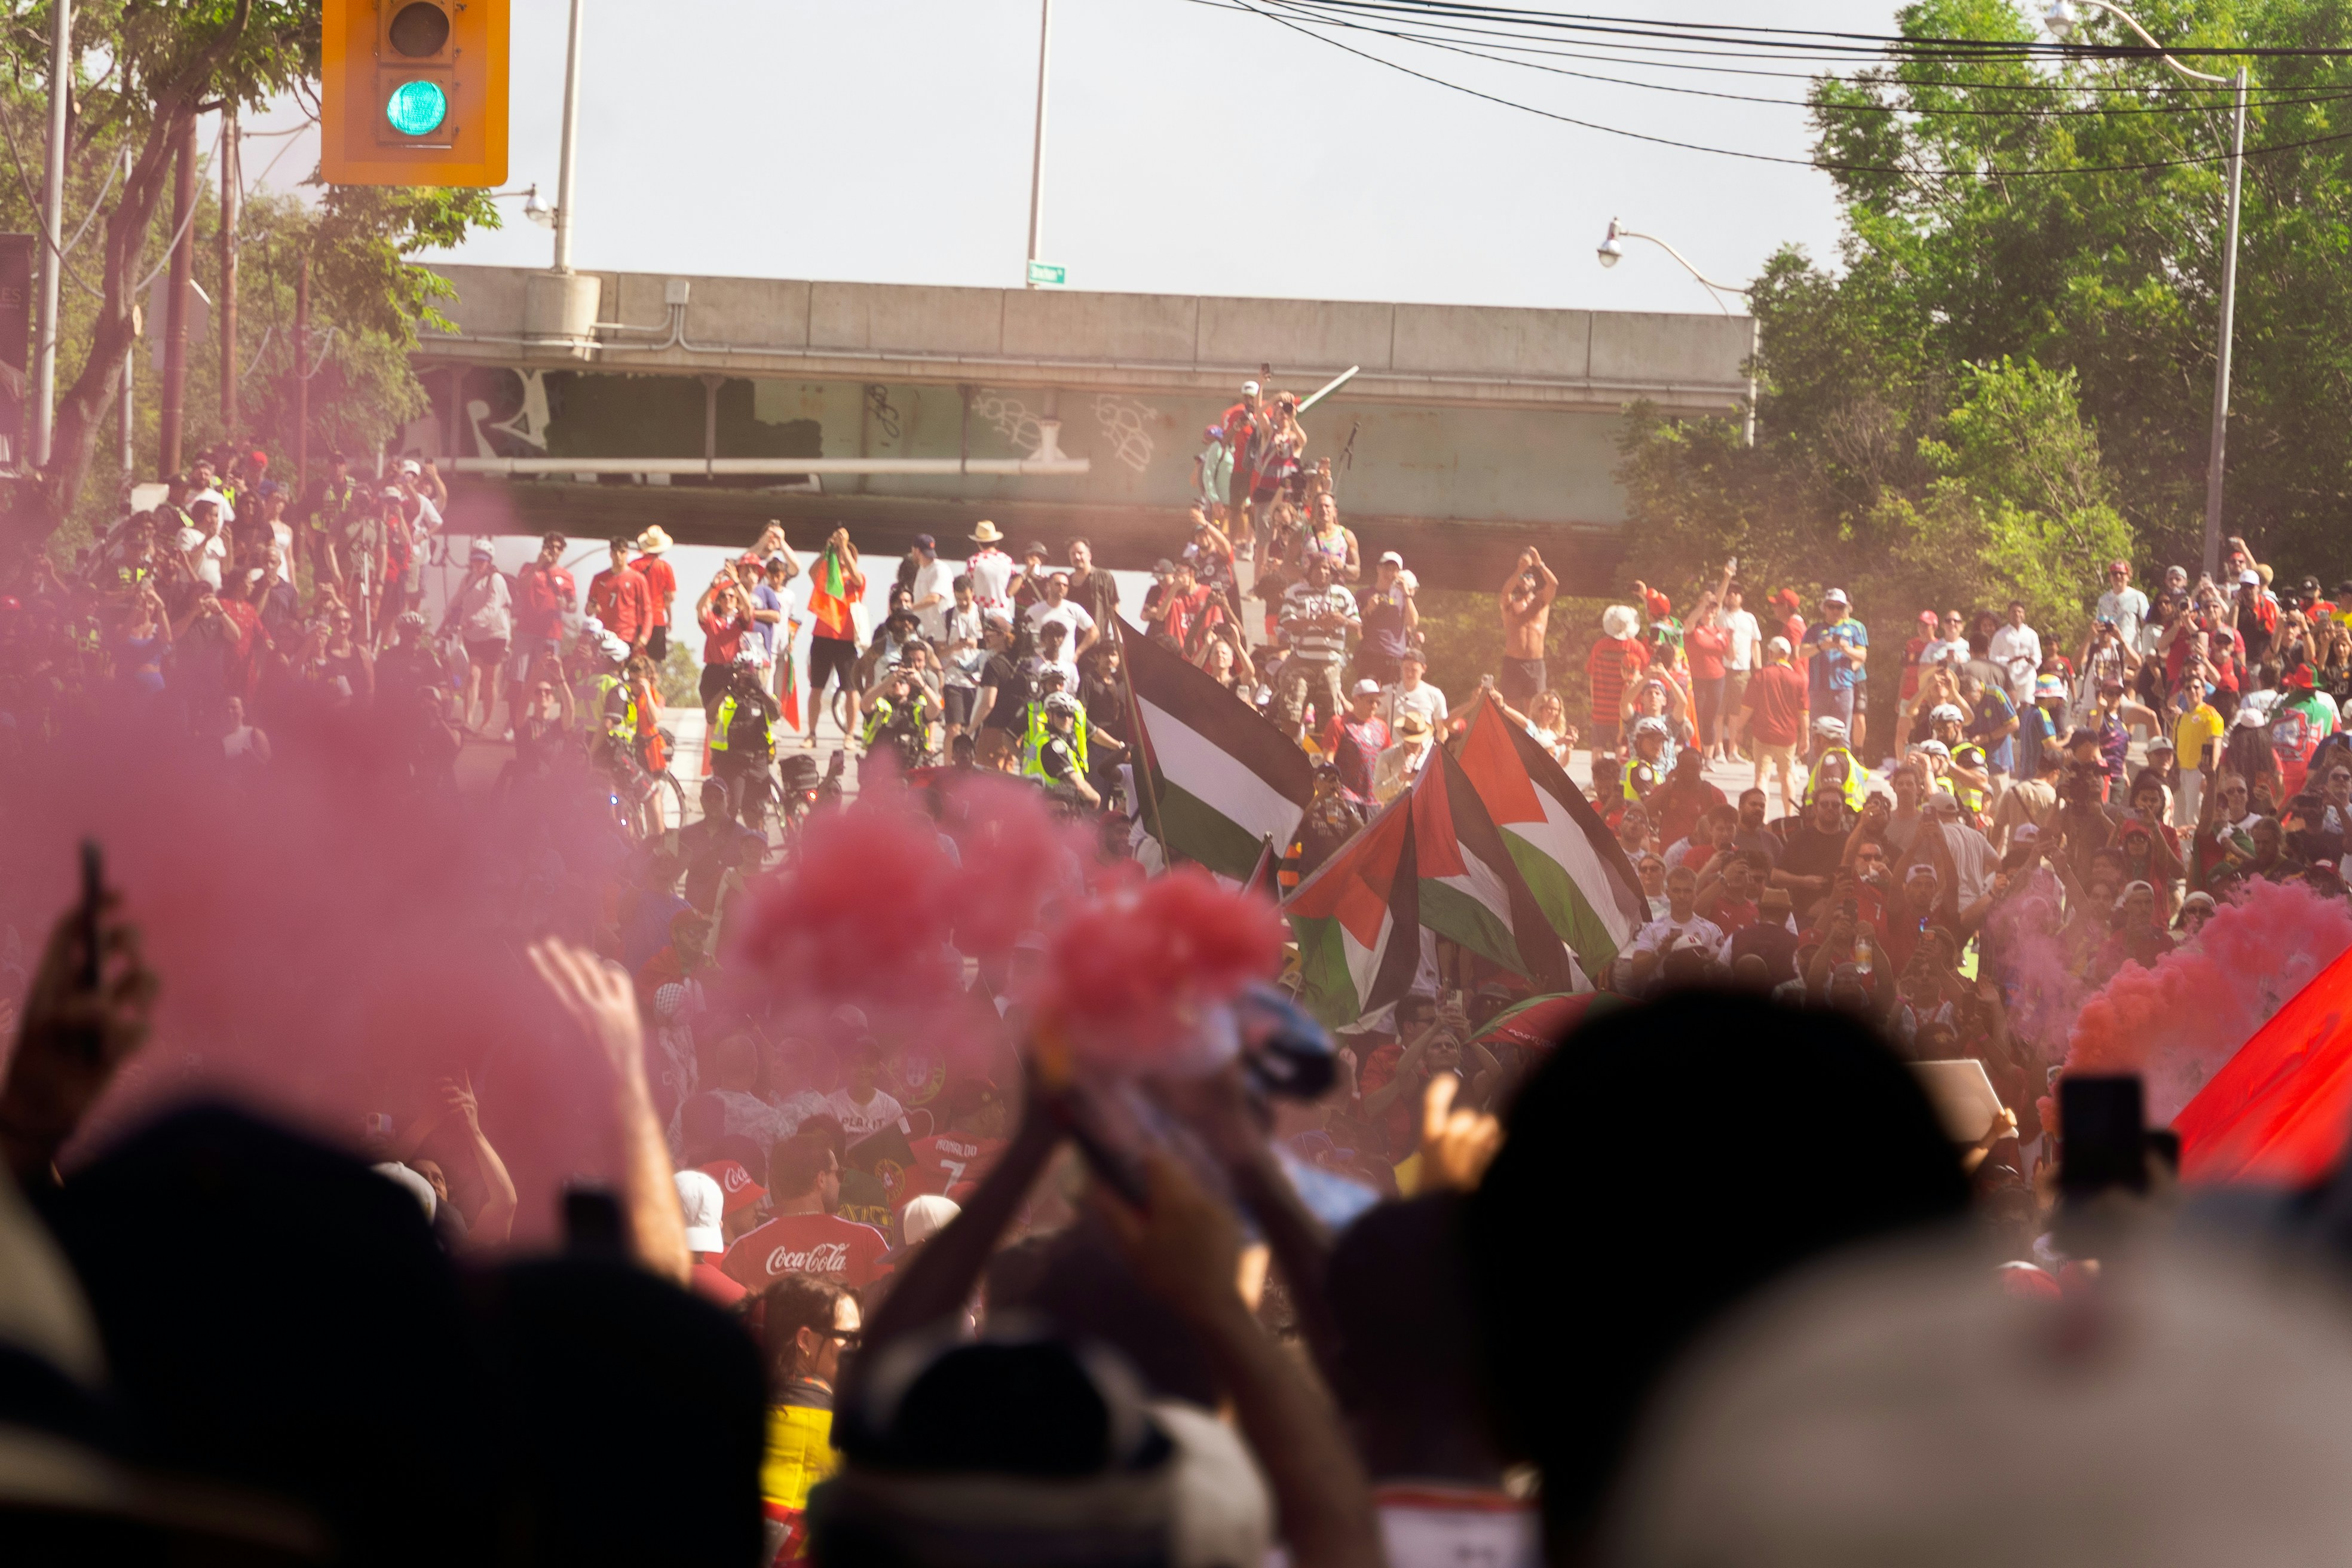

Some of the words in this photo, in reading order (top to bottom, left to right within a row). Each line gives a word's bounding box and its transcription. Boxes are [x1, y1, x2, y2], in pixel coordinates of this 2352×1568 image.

[1508, 1028, 1558, 1048] PORTUGA
[935, 1138, 978, 1157] RONALDO
[940, 1159, 967, 1198] 7
